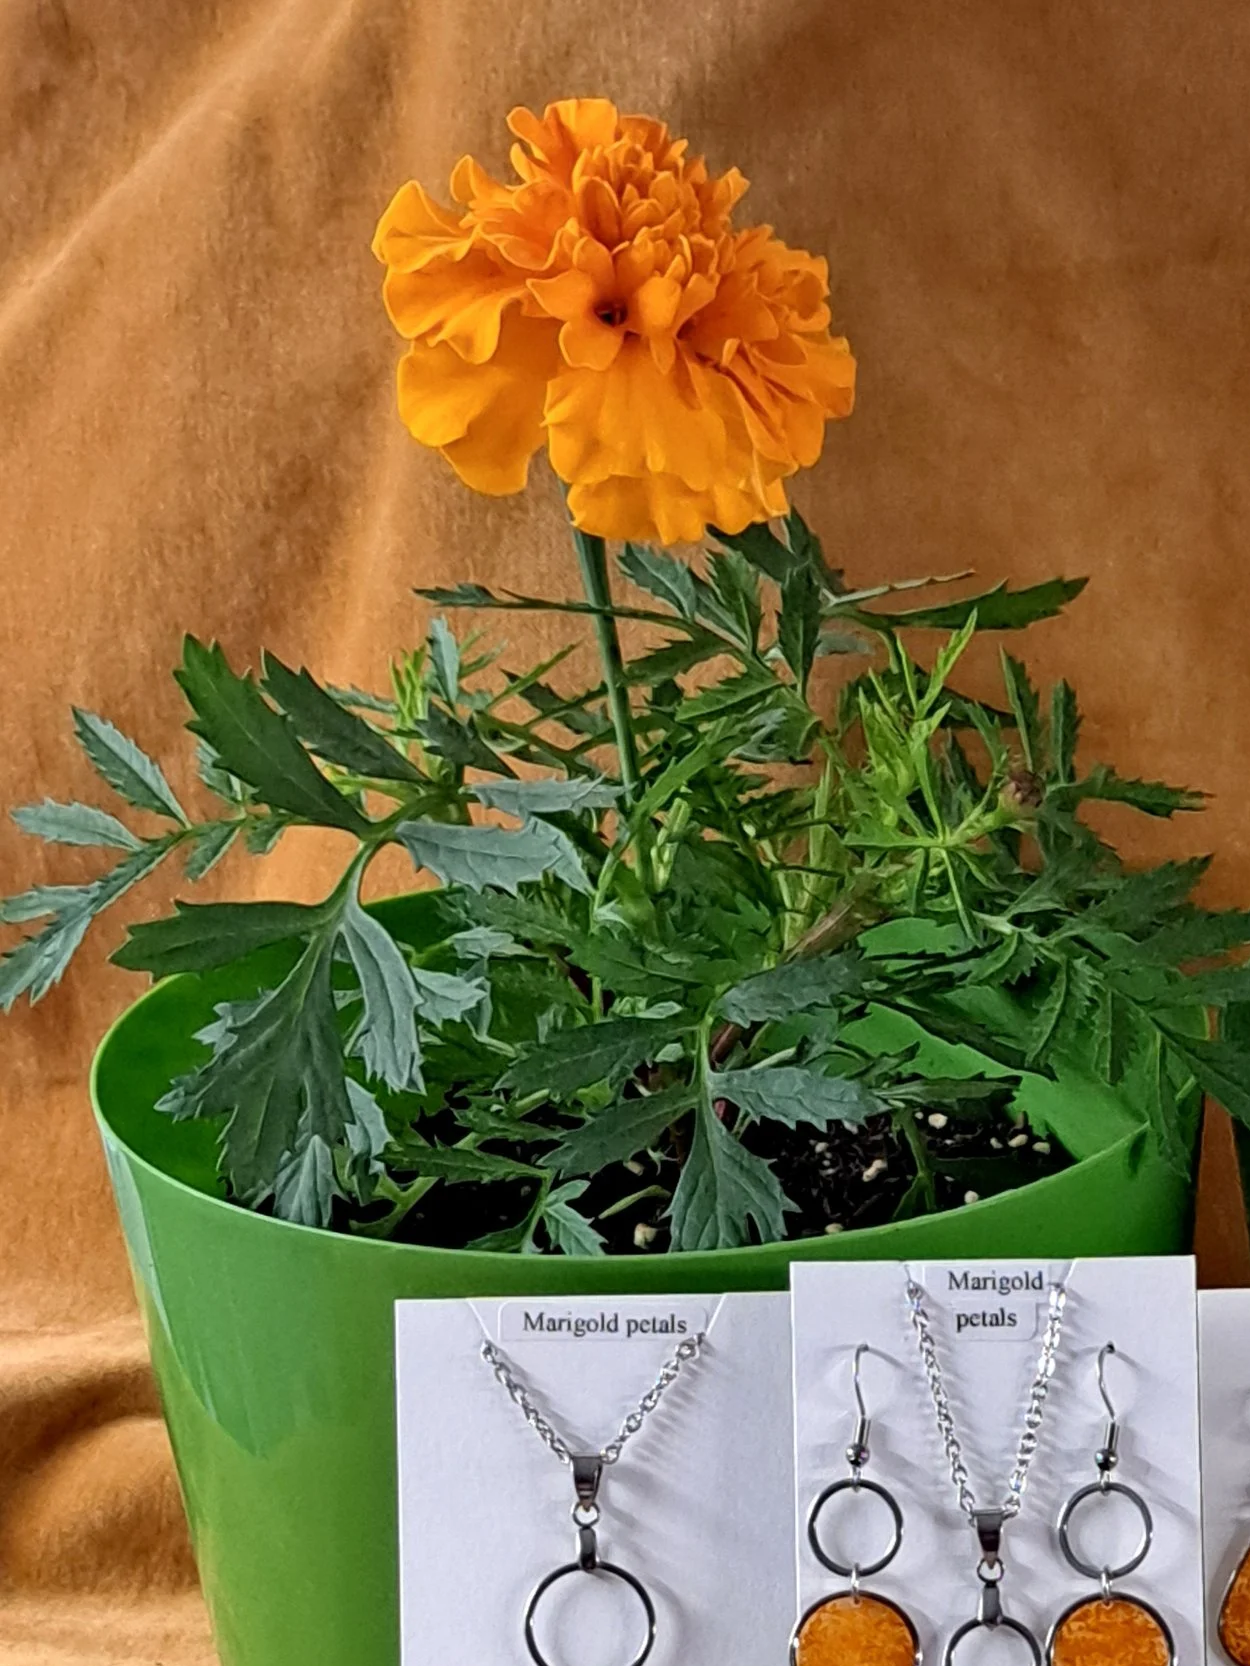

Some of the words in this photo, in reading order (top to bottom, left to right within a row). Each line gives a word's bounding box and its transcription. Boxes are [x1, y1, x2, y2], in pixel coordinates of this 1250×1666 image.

[949, 1271, 1043, 1295] Marigold
[524, 1312, 618, 1337] Marigold
[627, 1314, 687, 1338] petals
[957, 1308, 1016, 1333] petals
